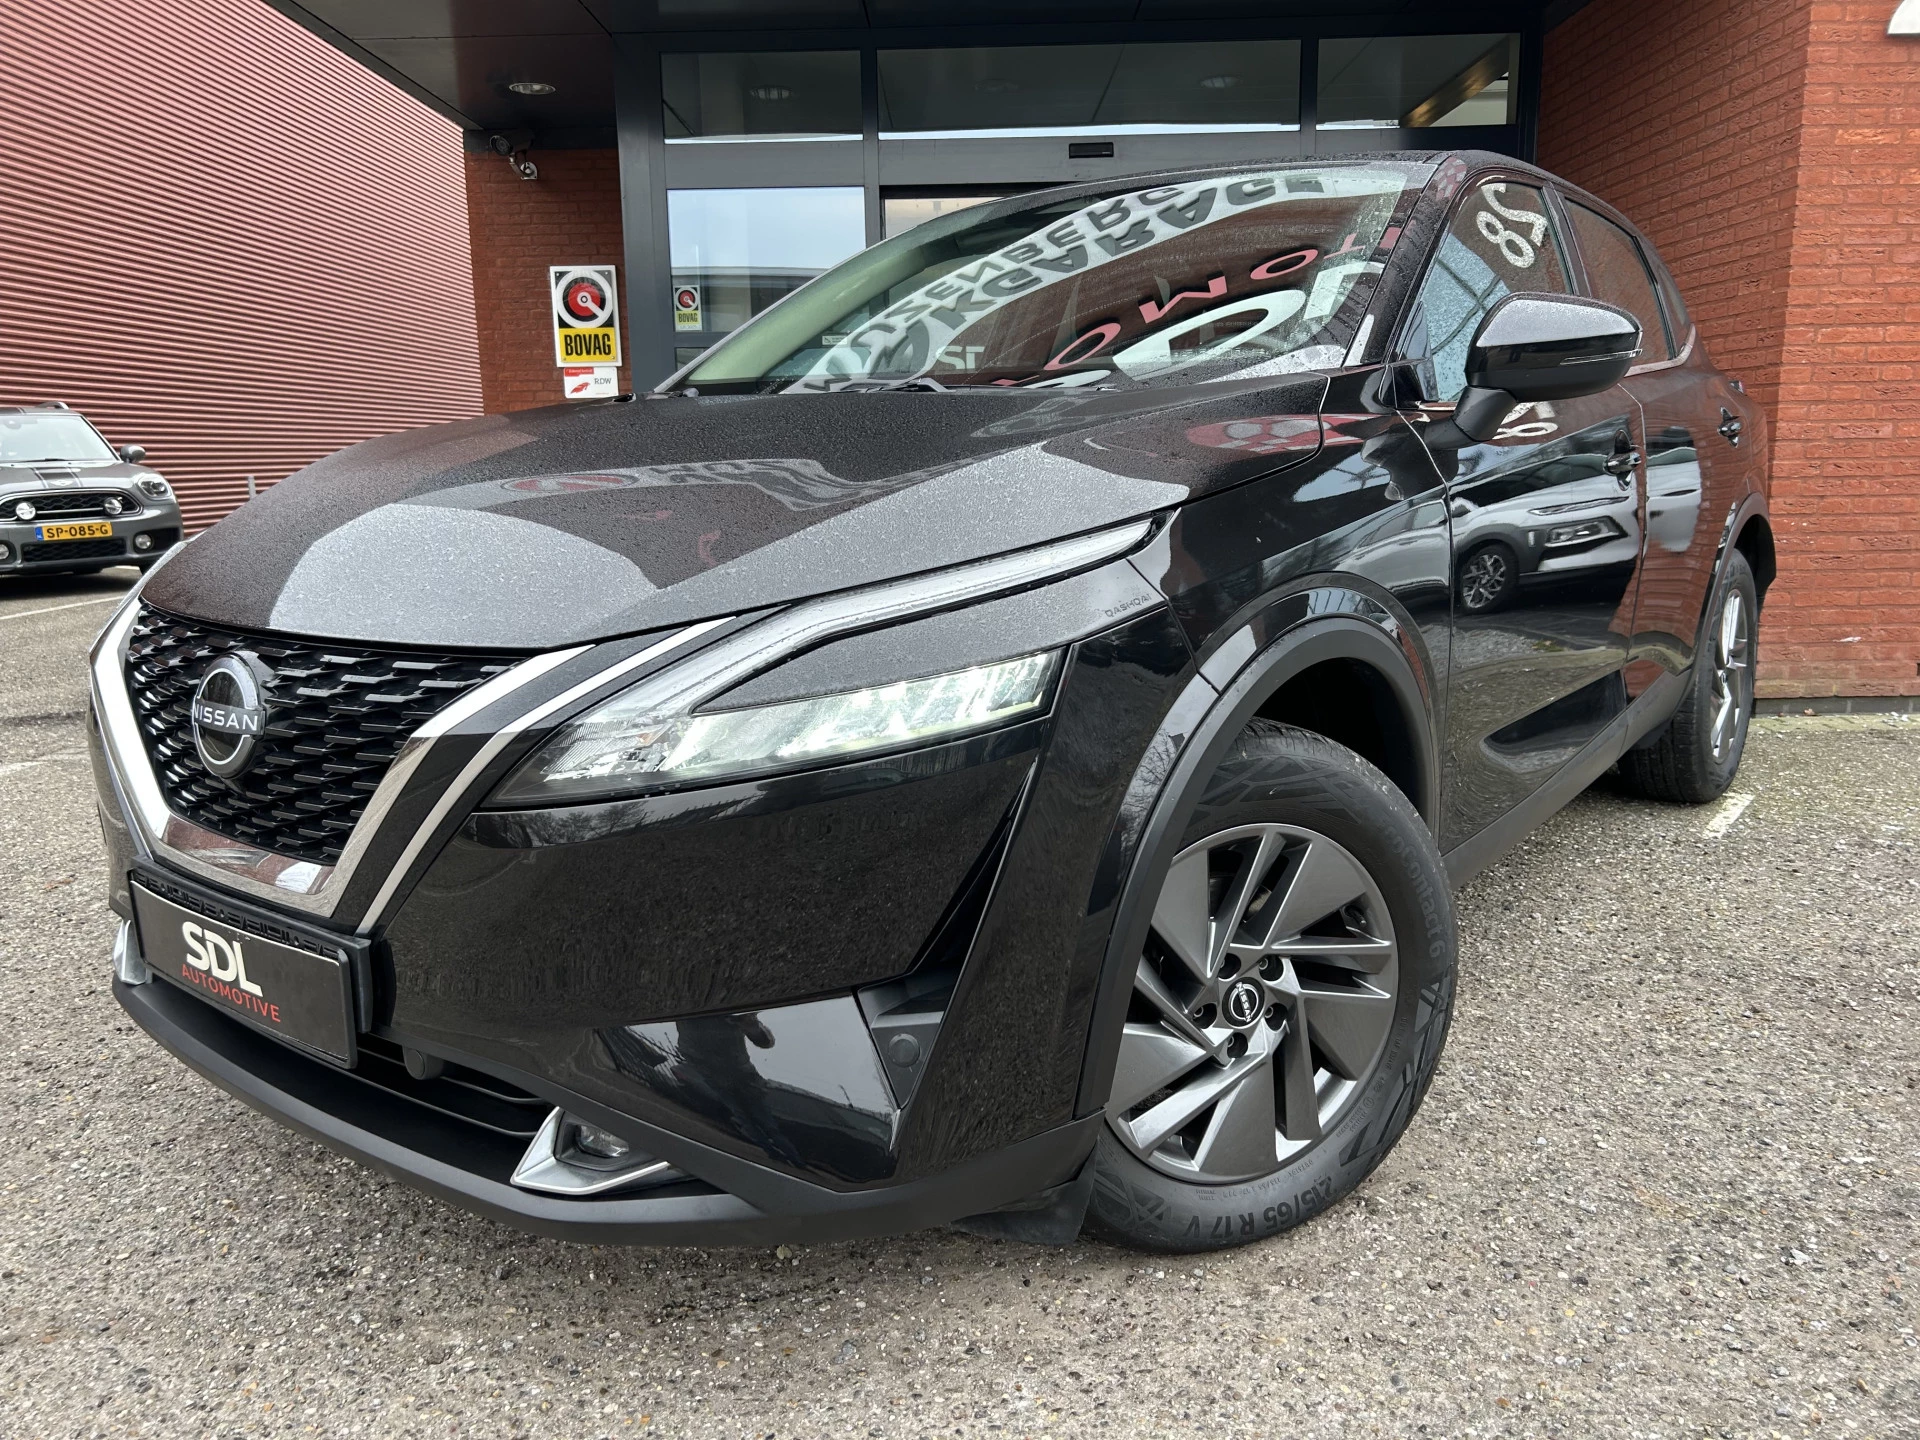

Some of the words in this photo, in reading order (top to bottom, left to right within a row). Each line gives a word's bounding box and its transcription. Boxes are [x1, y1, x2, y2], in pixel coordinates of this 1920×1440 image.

[678, 312, 698, 323] BOVAG
[564, 333, 612, 357] BOVAG
[594, 377, 612, 385] RDW
[46, 524, 109, 539] SP-085-G
[1104, 593, 1152, 618] QASHQAI
[193, 703, 258, 731] NISSAN
[181, 920, 264, 998] SDL
[181, 963, 282, 1023] AUTOMOTIVE
[1235, 981, 1252, 1023] NISSAN
[1262, 1174, 1336, 1231] 215/65
